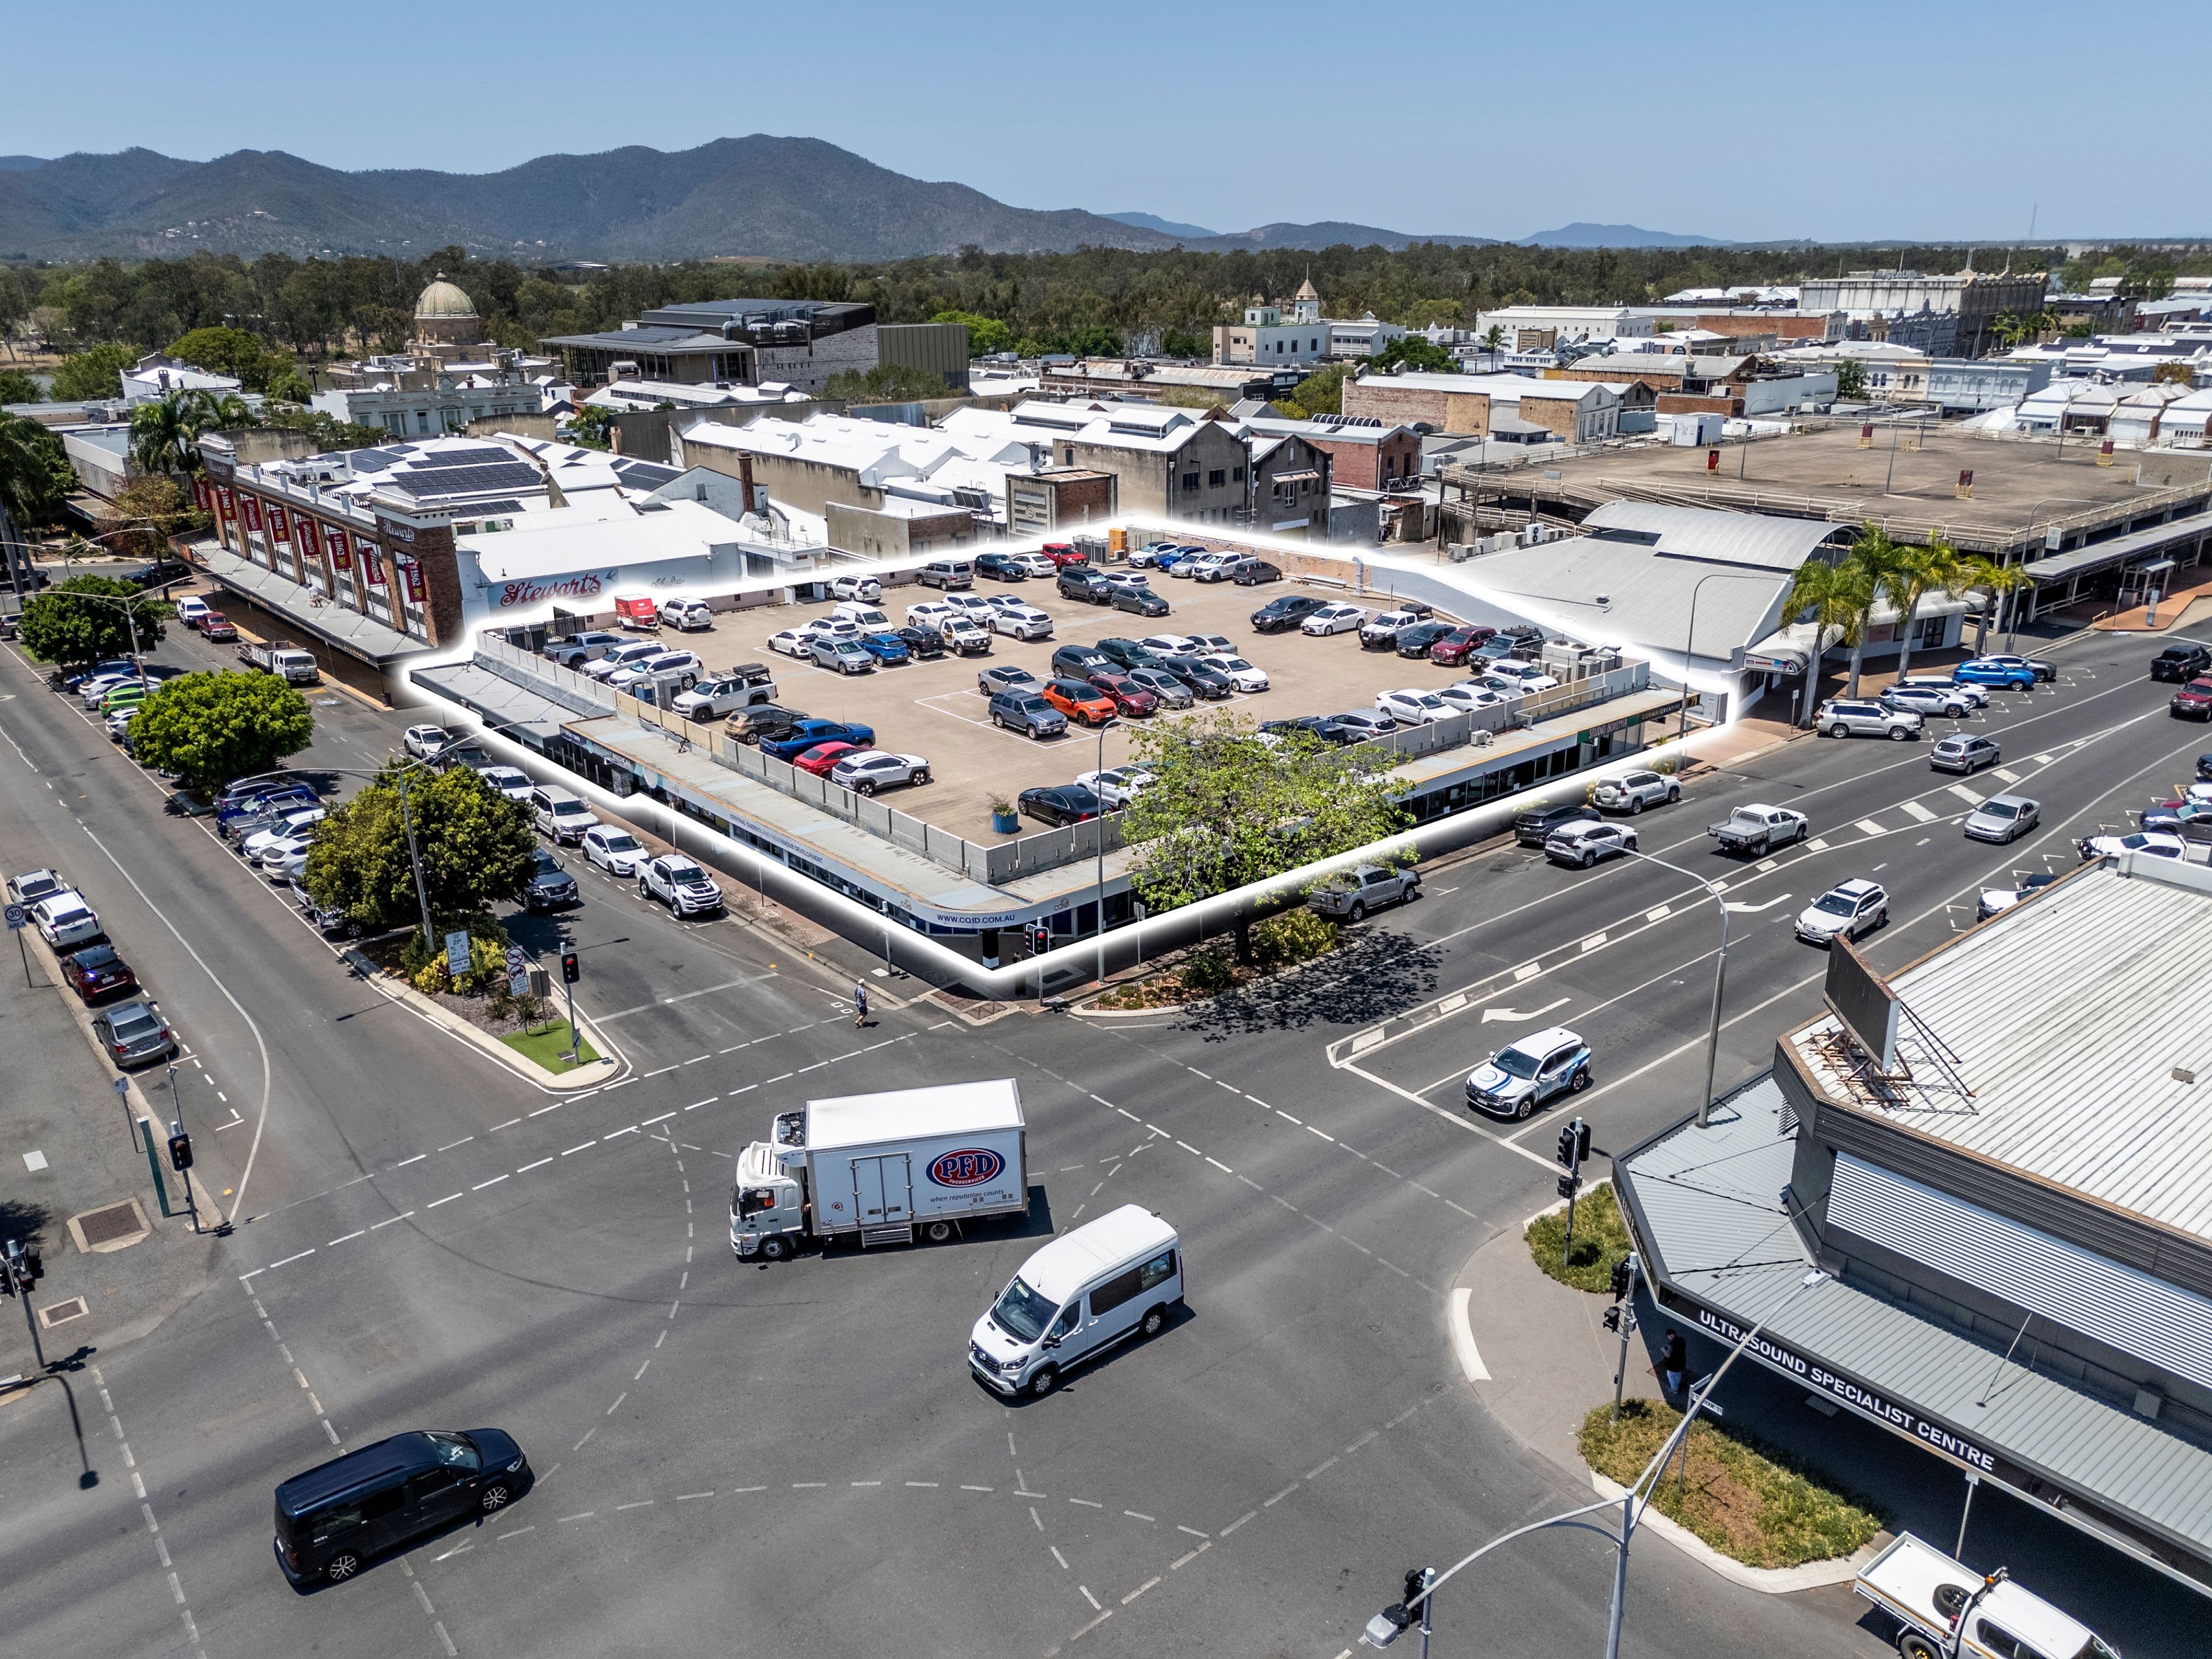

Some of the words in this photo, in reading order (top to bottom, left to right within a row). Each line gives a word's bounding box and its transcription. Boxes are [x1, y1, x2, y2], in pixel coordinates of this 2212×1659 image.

[221, 494, 231, 509] 1862
[274, 515, 283, 529] 1862
[335, 540, 345, 556] 1862
[410, 570, 421, 586] 1862
[1589, 724, 1606, 738] STUDIO
[1607, 718, 1627, 734] BOHEMIA
[612, 752, 631, 766] MEDICAL
[729, 814, 746, 827] CENTRAL
[794, 845, 823, 864] DEVELOPMENT
[9, 909, 21, 918] 30
[939, 1153, 995, 1179] PFD
[949, 1175, 985, 1184] FOODSERVICES
[949, 1191, 982, 1201] reputation
[1700, 1309, 1806, 1374] ULTRASOUND
[1810, 1368, 1914, 1428] SPECIALIST
[1918, 1422, 1994, 1472] CENTRE
